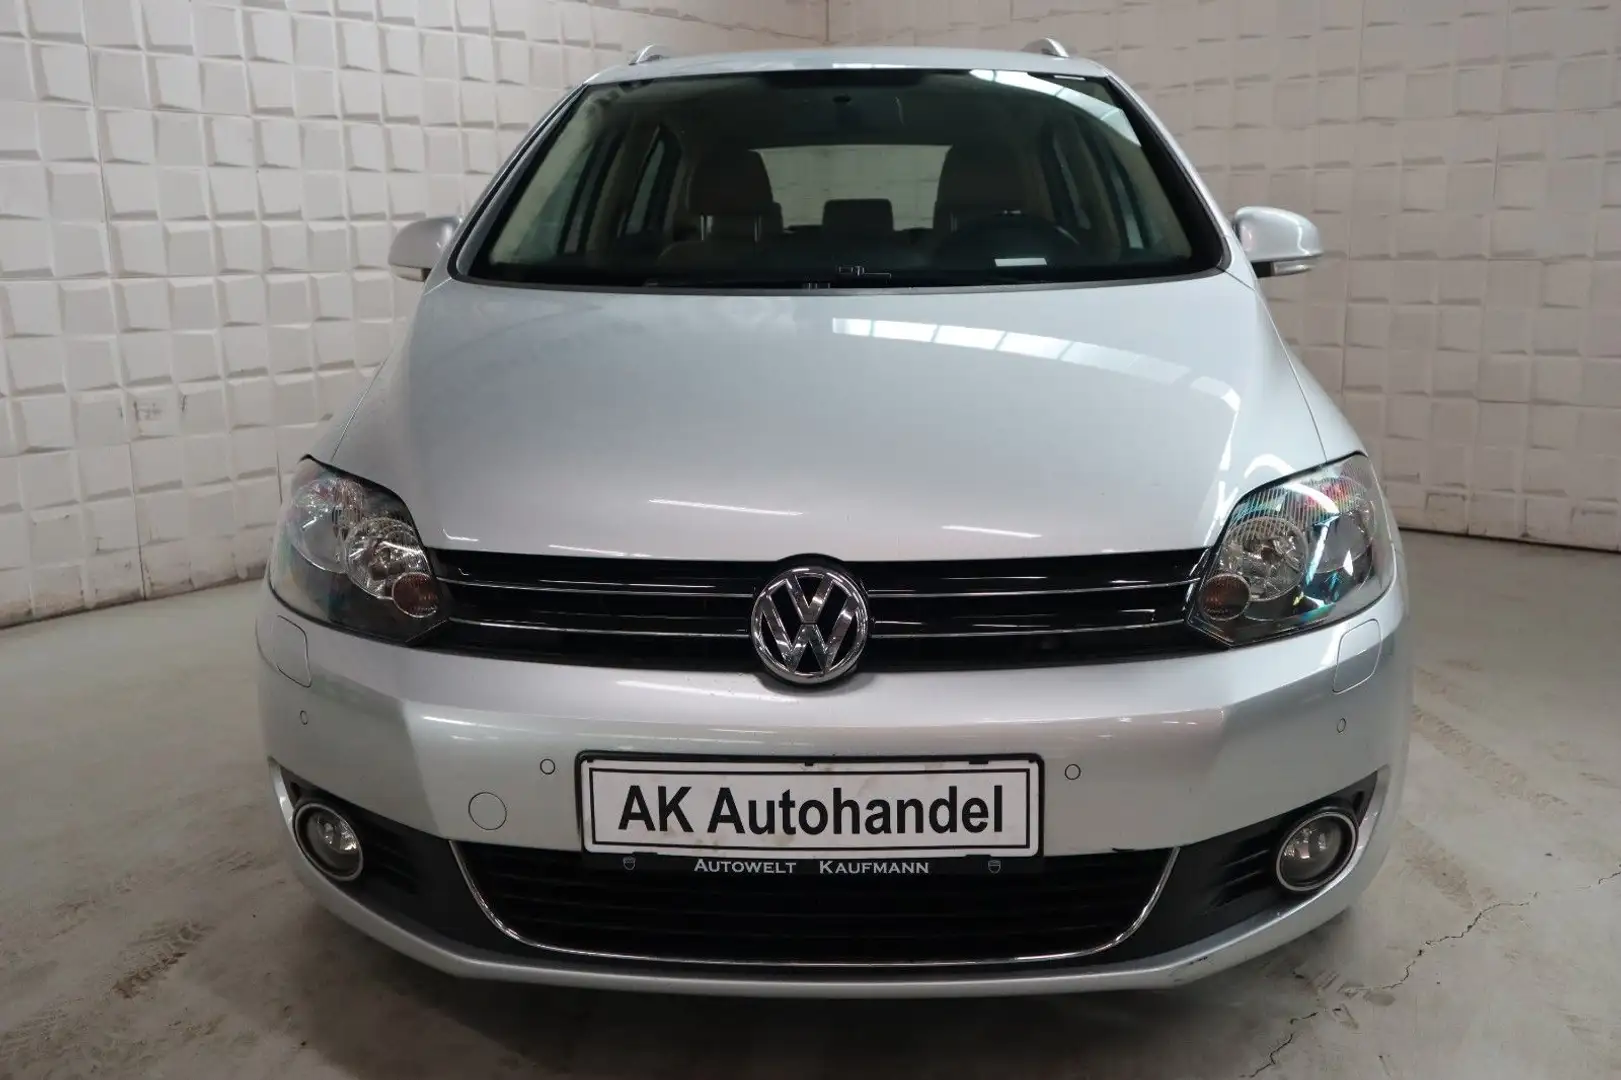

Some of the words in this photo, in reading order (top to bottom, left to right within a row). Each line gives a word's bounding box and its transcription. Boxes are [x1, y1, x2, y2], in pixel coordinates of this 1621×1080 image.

[755, 570, 865, 680] VW
[617, 785, 694, 833] AK
[706, 785, 1003, 835] Autohandel
[693, 858, 797, 875] AUTOWELT
[819, 860, 930, 875] KAUFMANN
